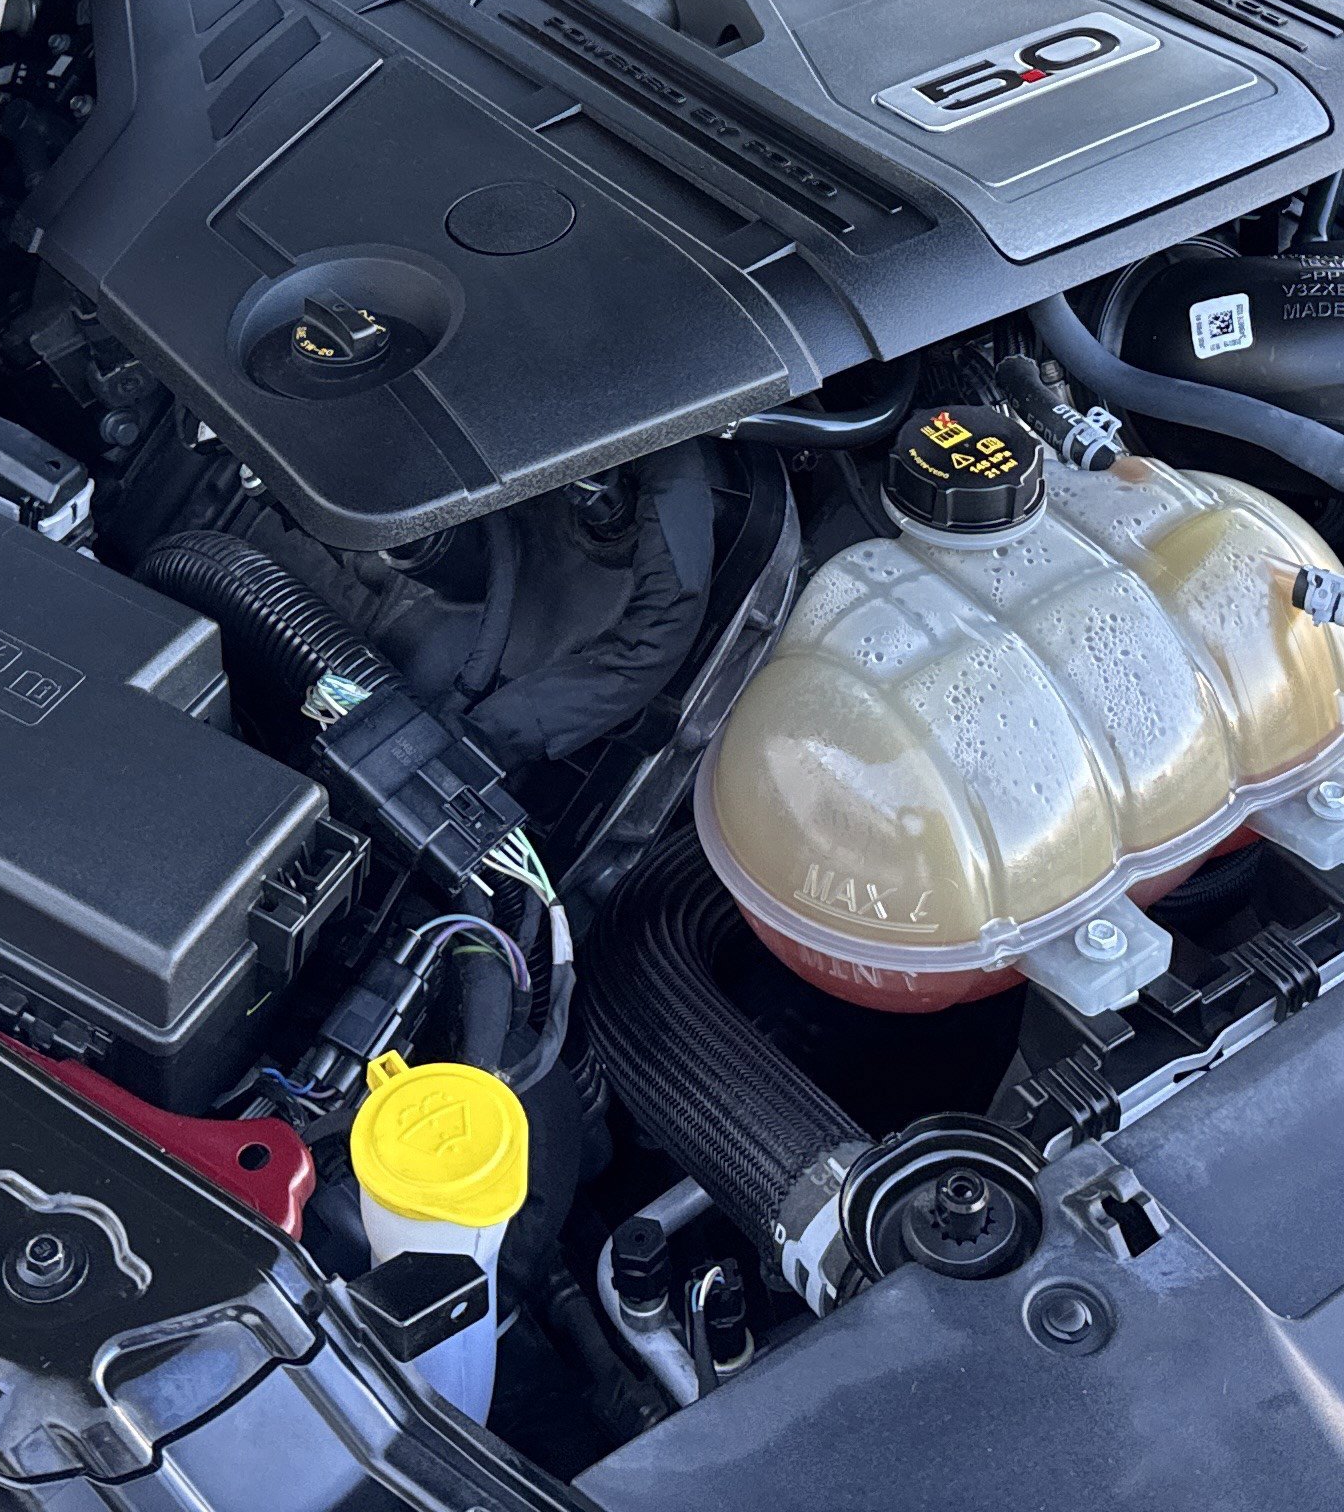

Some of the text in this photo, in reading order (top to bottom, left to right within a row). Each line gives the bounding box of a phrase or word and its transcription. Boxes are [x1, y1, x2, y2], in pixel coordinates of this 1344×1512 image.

[544, 16, 687, 105] POWERED
[911, 26, 1121, 111] 5.0
[803, 864, 898, 920] MAX
[801, 948, 882, 989] MIN
